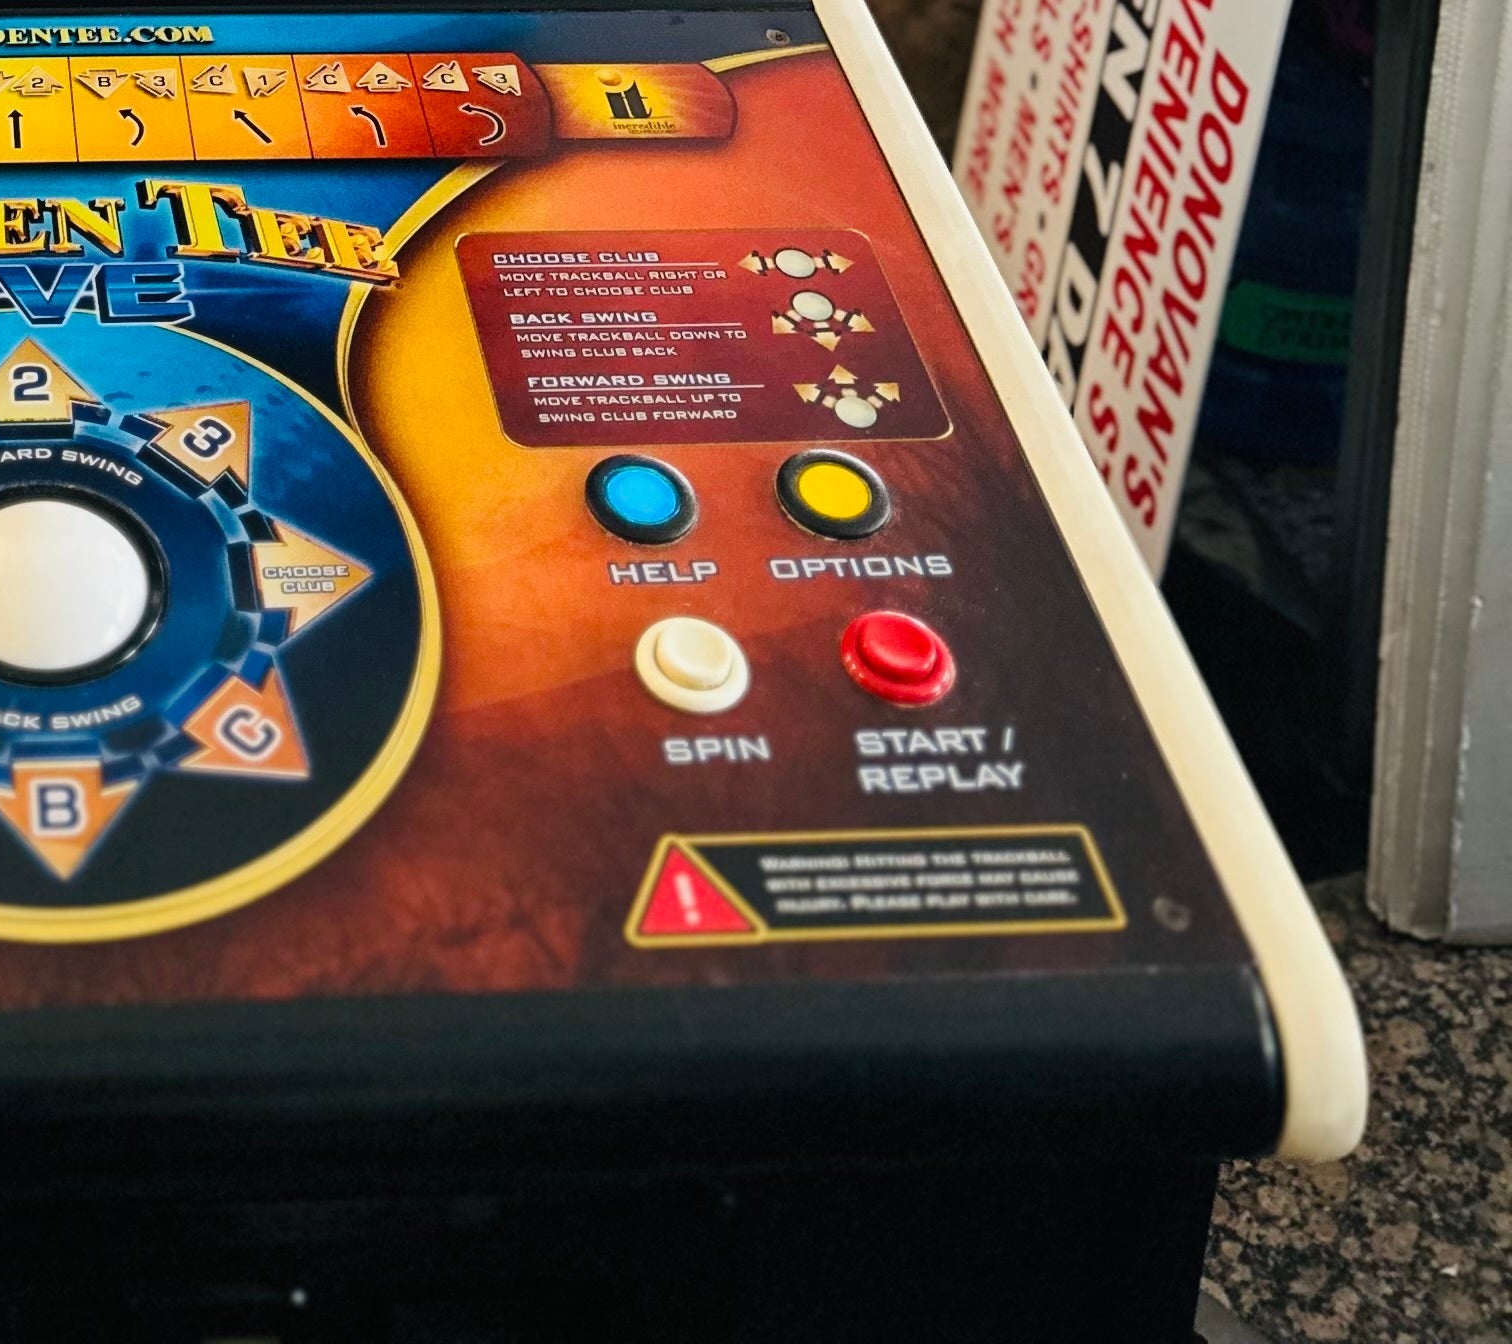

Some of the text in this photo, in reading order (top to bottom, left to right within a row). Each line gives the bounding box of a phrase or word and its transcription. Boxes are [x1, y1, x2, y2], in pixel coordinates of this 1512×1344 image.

[144, 179, 399, 284] TEE
[493, 251, 661, 264] CHOOSE CLUB
[499, 269, 727, 282] MOVE TRACKBALL RIGHT OR
[503, 285, 695, 297] LEFT TO CHOOSE CLUB
[1124, 49, 1250, 529] DONOVAN'S
[510, 312, 658, 325] BACK SWING
[516, 330, 748, 342] MOVE TRACKBALL DOWN TO
[521, 346, 678, 358] SWING CLUB BACK
[9, 363, 52, 403] 2
[527, 372, 731, 388] FORWARD SWING
[534, 393, 742, 406] MOVE TRACKBALL UP TO
[538, 409, 738, 423] SWING CLUB FORWARD
[178, 416, 233, 459] 3
[61, 448, 146, 487] SWING
[261, 564, 350, 580] CHOOSE
[609, 555, 954, 583] HELP OPTIONS
[281, 578, 336, 594] CLUB
[51, 694, 145, 732] SWING
[216, 708, 279, 760] C
[664, 728, 986, 764] SPIN START
[858, 762, 1025, 793] REPLAY
[35, 782, 82, 830] B
